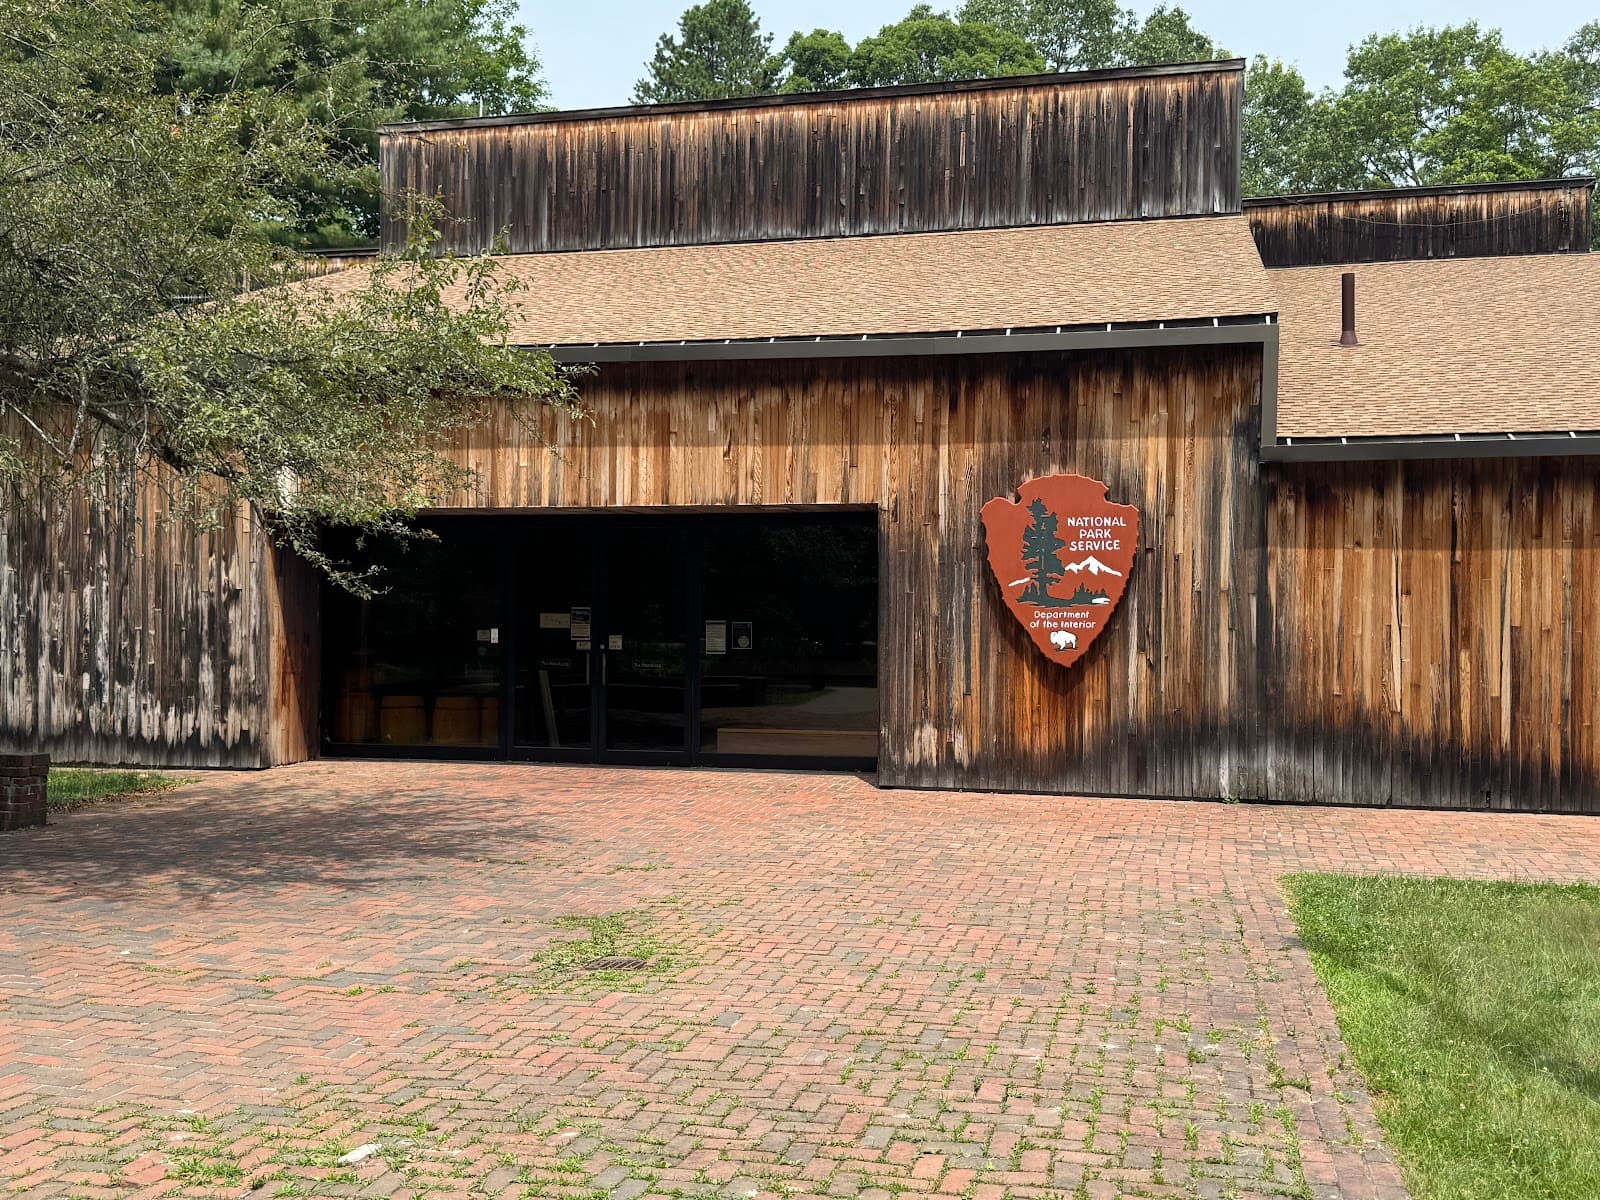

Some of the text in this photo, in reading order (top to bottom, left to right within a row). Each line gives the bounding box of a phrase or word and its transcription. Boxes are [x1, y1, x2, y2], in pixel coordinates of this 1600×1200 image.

[1067, 516, 1127, 527] NATIONAL
[1079, 528, 1112, 539] PARK
[1069, 539, 1121, 551] SERVICE
[1034, 610, 1090, 620] Department
[1029, 619, 1097, 629] of the Interior
